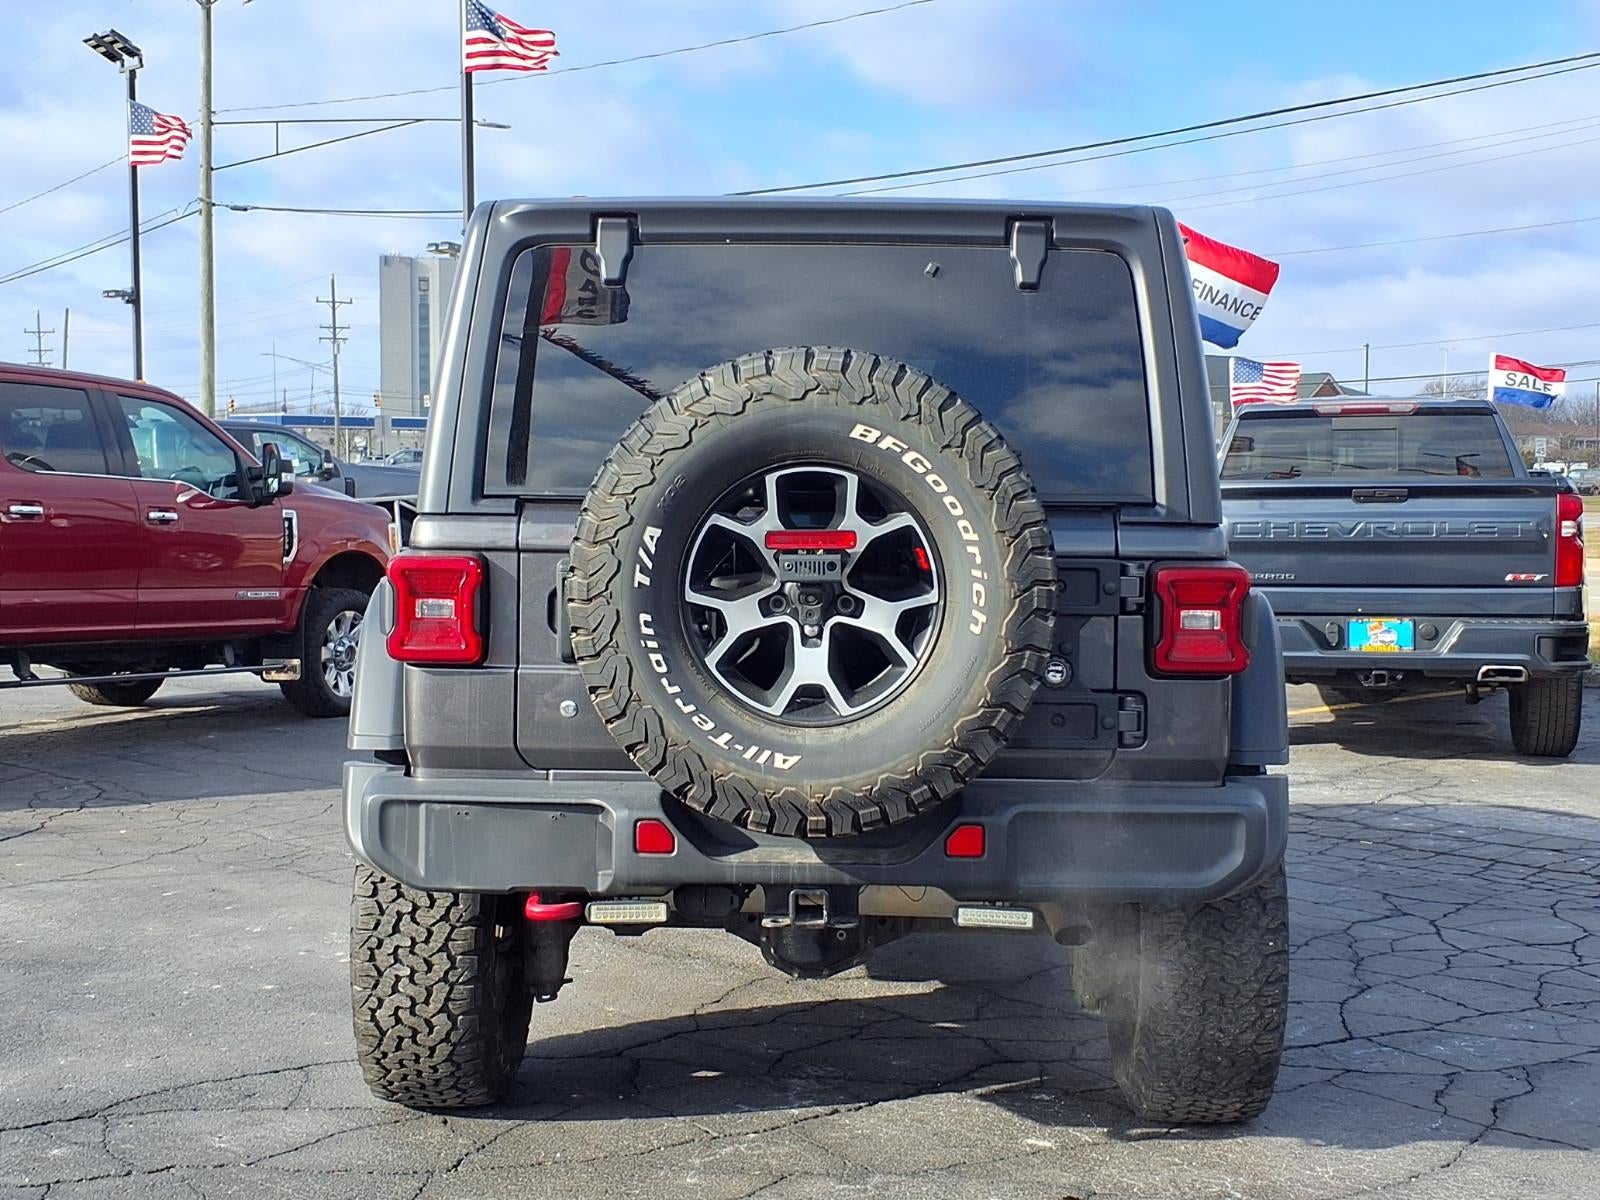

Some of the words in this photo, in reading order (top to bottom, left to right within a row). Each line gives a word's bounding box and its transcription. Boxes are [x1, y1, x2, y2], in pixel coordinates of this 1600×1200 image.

[1192, 278, 1262, 321] FINANCE
[1505, 372, 1552, 392] SALE
[849, 423, 988, 635] BFGoodrich
[1232, 521, 1533, 538] CHEVROLET
[633, 525, 662, 588] T/A
[638, 612, 802, 770] All-Terrain
